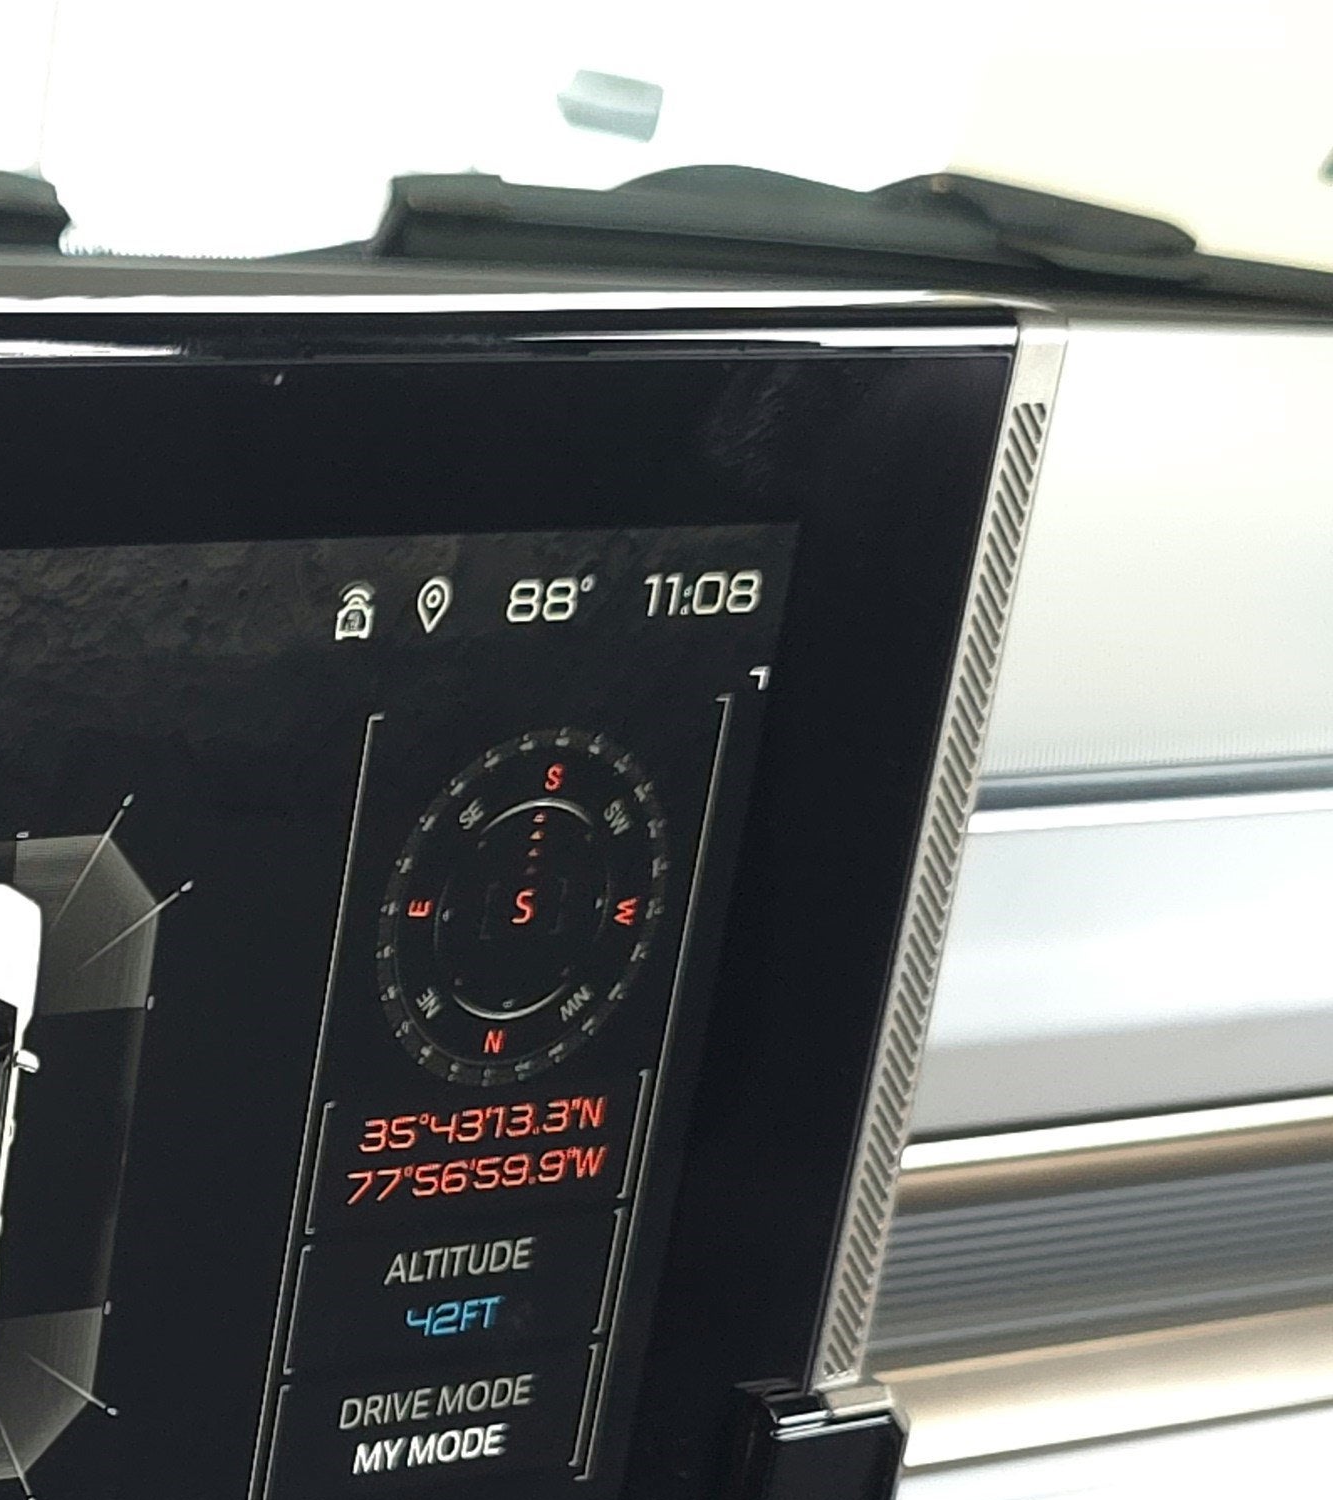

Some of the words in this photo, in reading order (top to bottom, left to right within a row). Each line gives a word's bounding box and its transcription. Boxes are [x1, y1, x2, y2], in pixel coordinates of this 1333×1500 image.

[505, 573, 597, 624] 88°
[643, 569, 763, 618] 11:08
[511, 887, 537, 925] S
[383, 1235, 535, 1286] ALTITUDE
[405, 1294, 504, 1336] 42FT
[339, 1384, 431, 1430] DRIVE
[435, 1372, 535, 1418] MODE
[351, 1438, 405, 1476] MY
[406, 1421, 509, 1465] MODE
